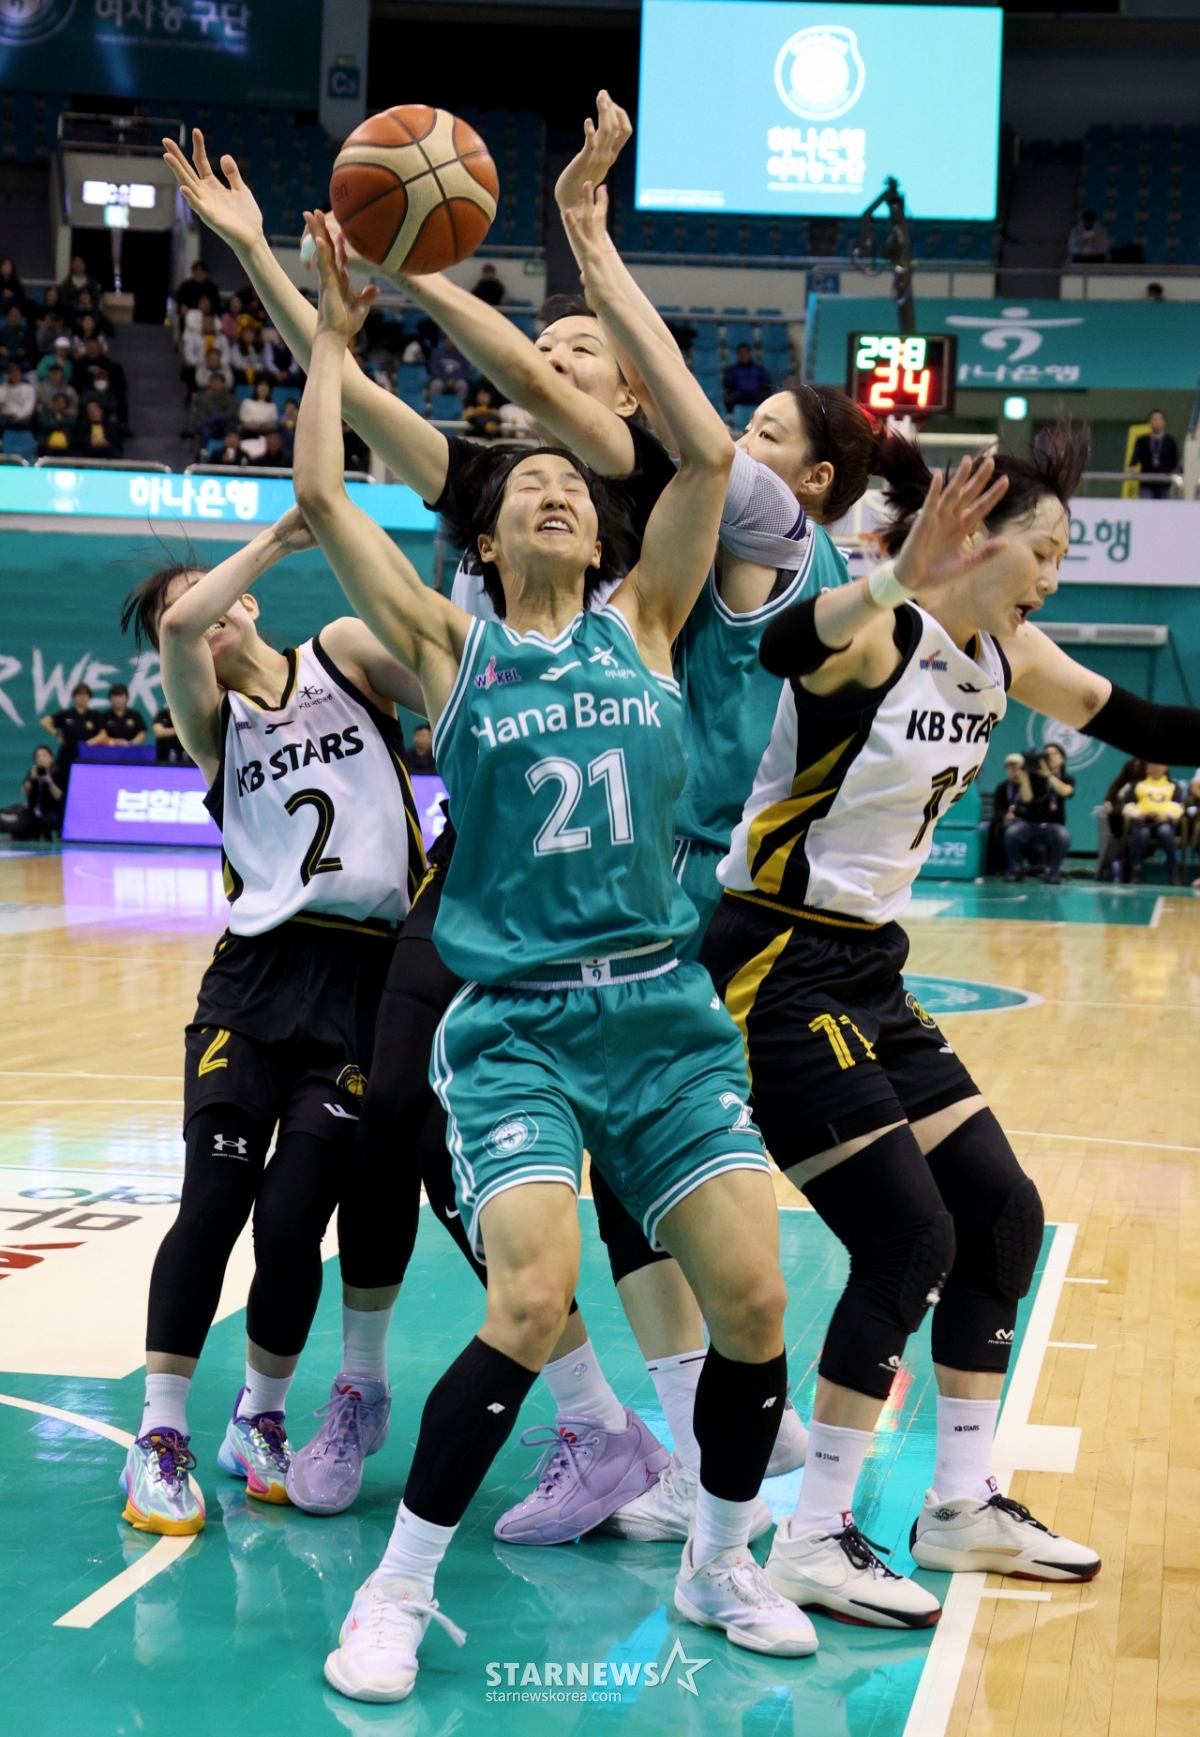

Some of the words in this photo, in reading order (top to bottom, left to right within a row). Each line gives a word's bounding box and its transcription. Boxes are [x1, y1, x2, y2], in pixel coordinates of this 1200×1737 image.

[869, 367, 930, 408] 24
[129, 476, 259, 520] 하나은행
[471, 702, 568, 748] Hana
[573, 690, 661, 729] Bank
[906, 709, 945, 741] KB
[236, 760, 265, 797] KB
[269, 725, 364, 781] STARS
[524, 748, 634, 857] 21
[283, 787, 343, 887] 2
[198, 1028, 231, 1077] 2
